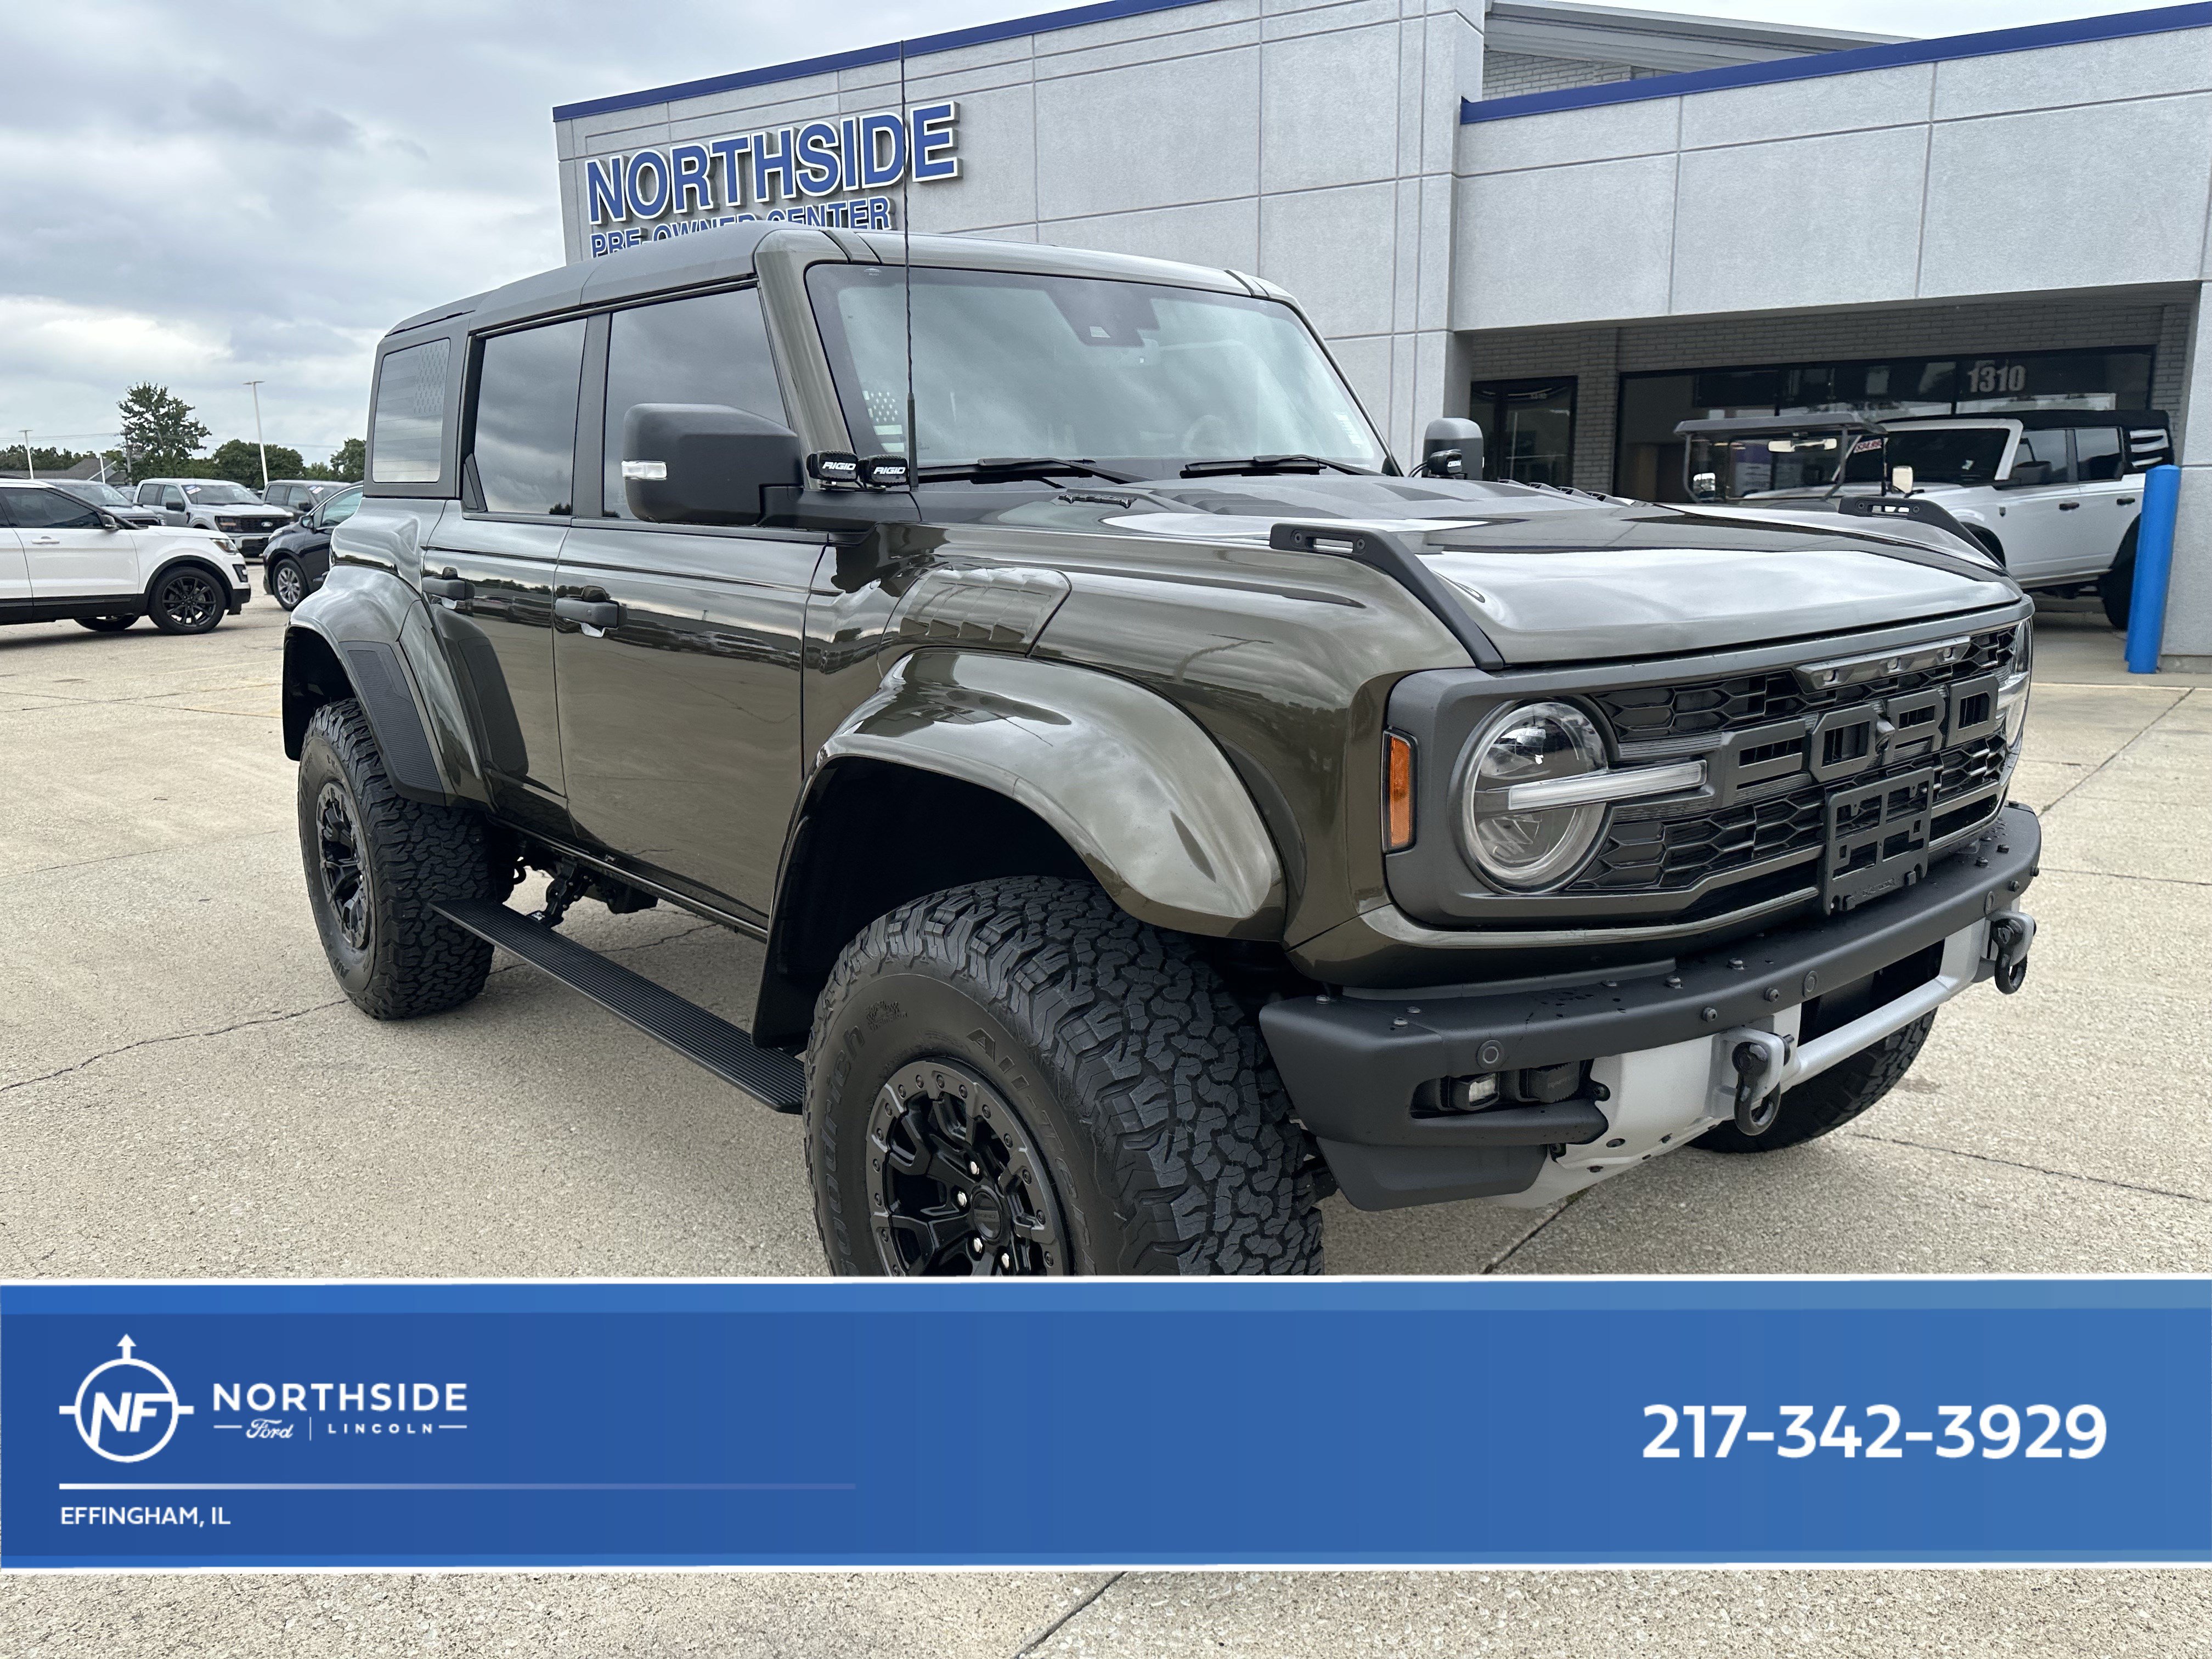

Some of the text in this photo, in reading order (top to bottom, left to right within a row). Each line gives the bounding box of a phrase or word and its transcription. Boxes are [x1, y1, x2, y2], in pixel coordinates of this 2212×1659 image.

[585, 100, 958, 225] NORTHSIDE
[1967, 365, 2026, 392] 1310
[822, 461, 856, 471] RIGID
[873, 466, 906, 475] RIGID
[1720, 674, 1999, 806] FORD
